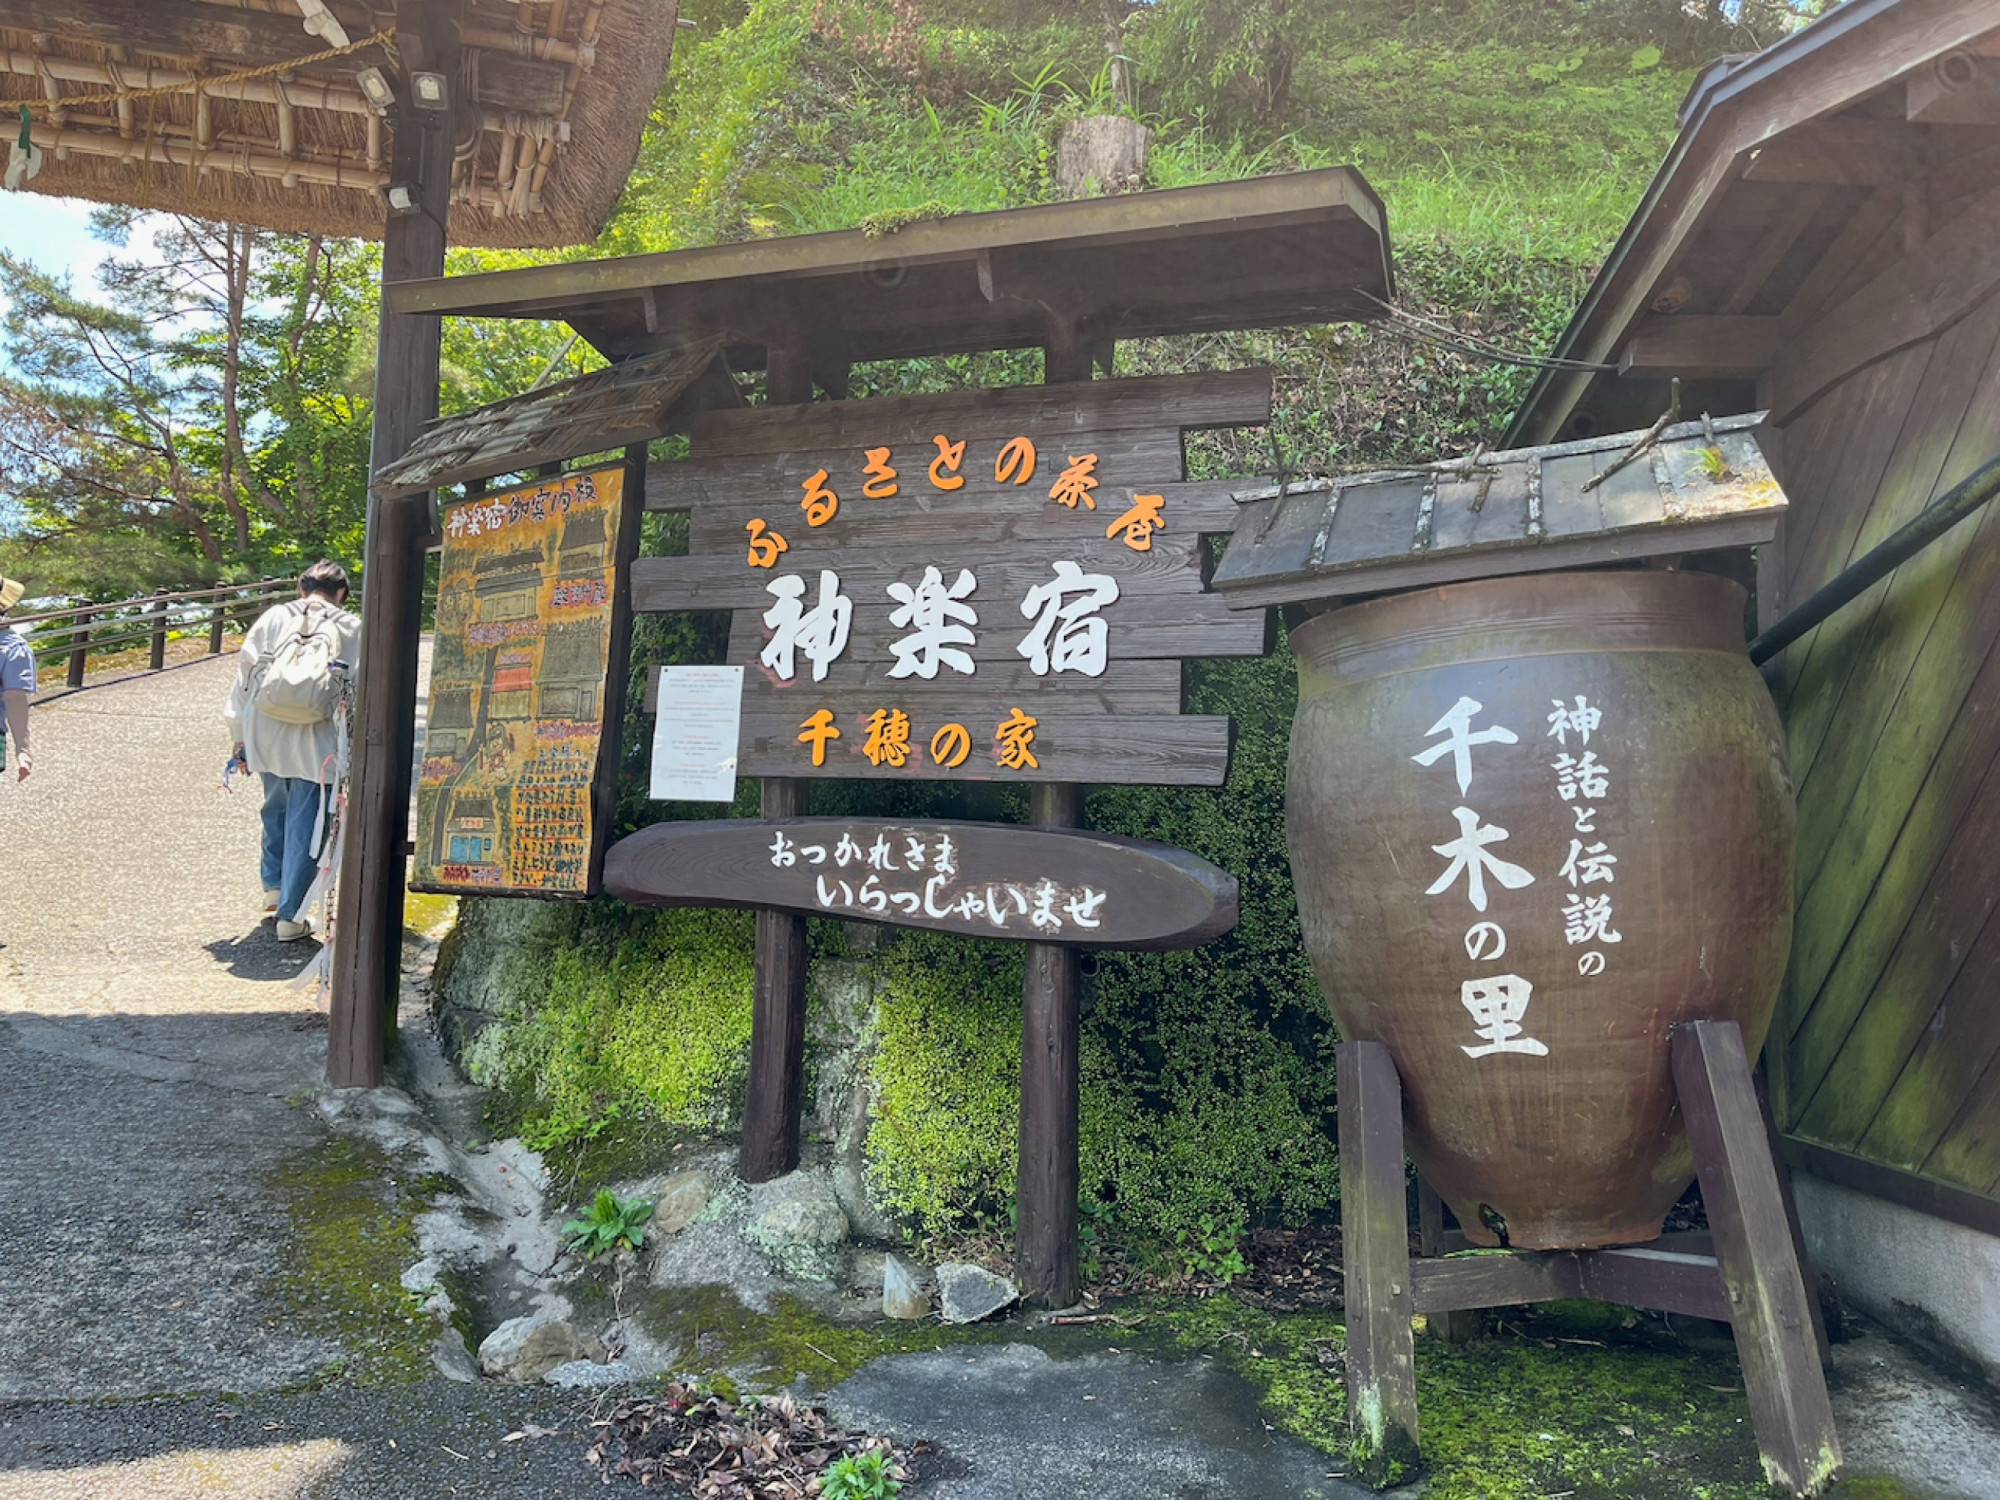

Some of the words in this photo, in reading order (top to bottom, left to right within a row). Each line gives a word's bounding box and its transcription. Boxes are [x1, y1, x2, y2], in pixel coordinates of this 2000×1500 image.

[745, 435, 1165, 568] ふるさとの茶屋
[760, 561, 1119, 681] 神楽宿
[798, 708, 1039, 769] 千穂の家
[1411, 696, 1549, 1059] 千木の里
[1547, 695, 1622, 977] 神話と伝説の
[816, 874, 1107, 929] いらっしゃいませ
